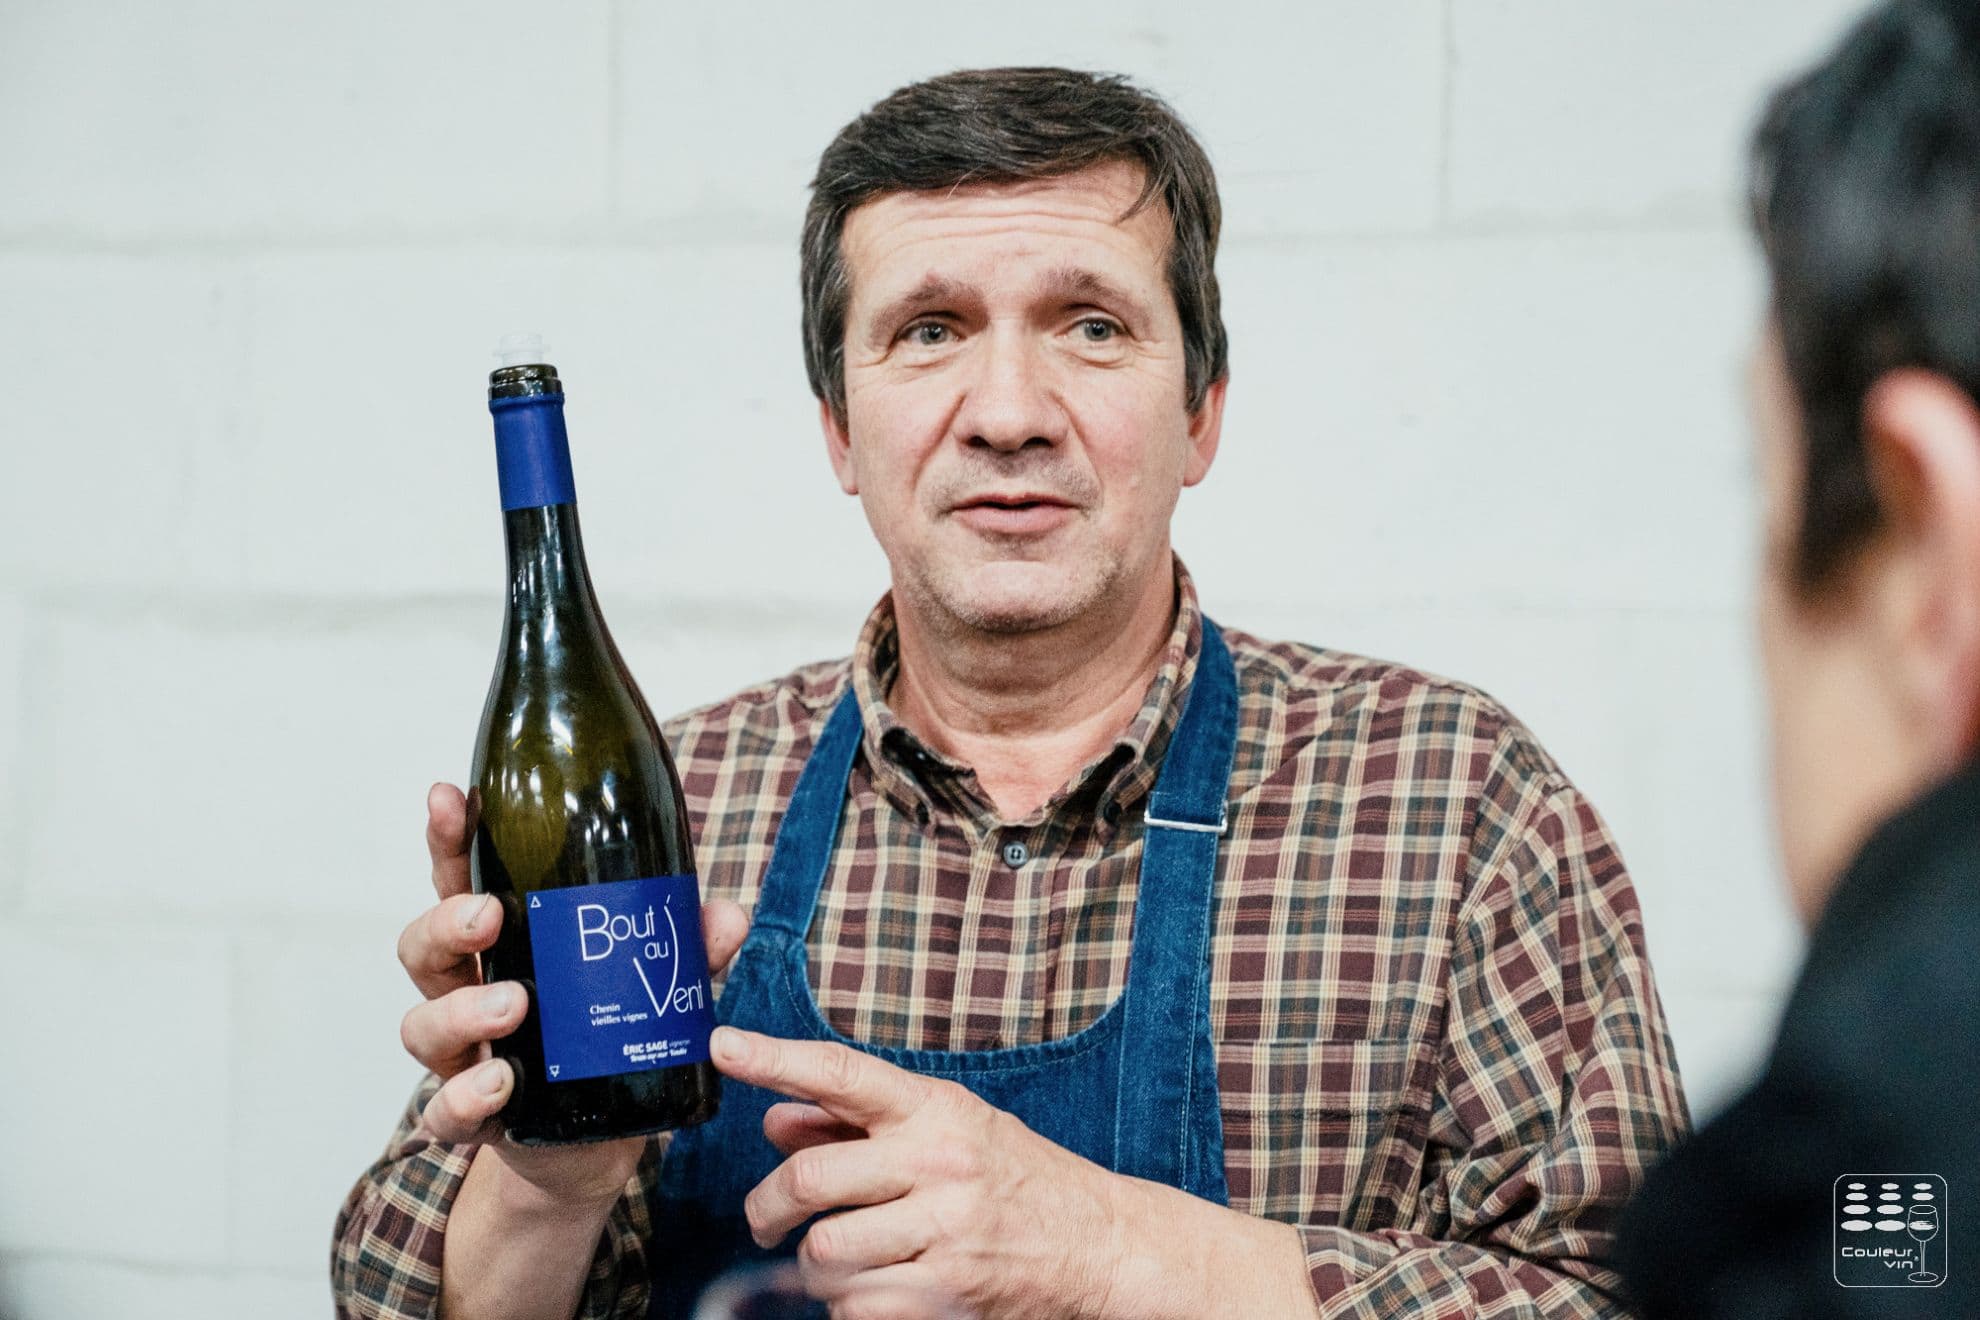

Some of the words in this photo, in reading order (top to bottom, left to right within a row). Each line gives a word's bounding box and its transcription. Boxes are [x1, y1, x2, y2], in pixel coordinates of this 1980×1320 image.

[577, 904, 656, 962] Bout
[644, 940, 669, 960] au
[633, 904, 704, 1018] Vent
[589, 1003, 621, 1015] Chenin
[591, 1014, 621, 1027] vieilles
[622, 1012, 648, 1023] vignes
[645, 1040, 668, 1053] SAGE
